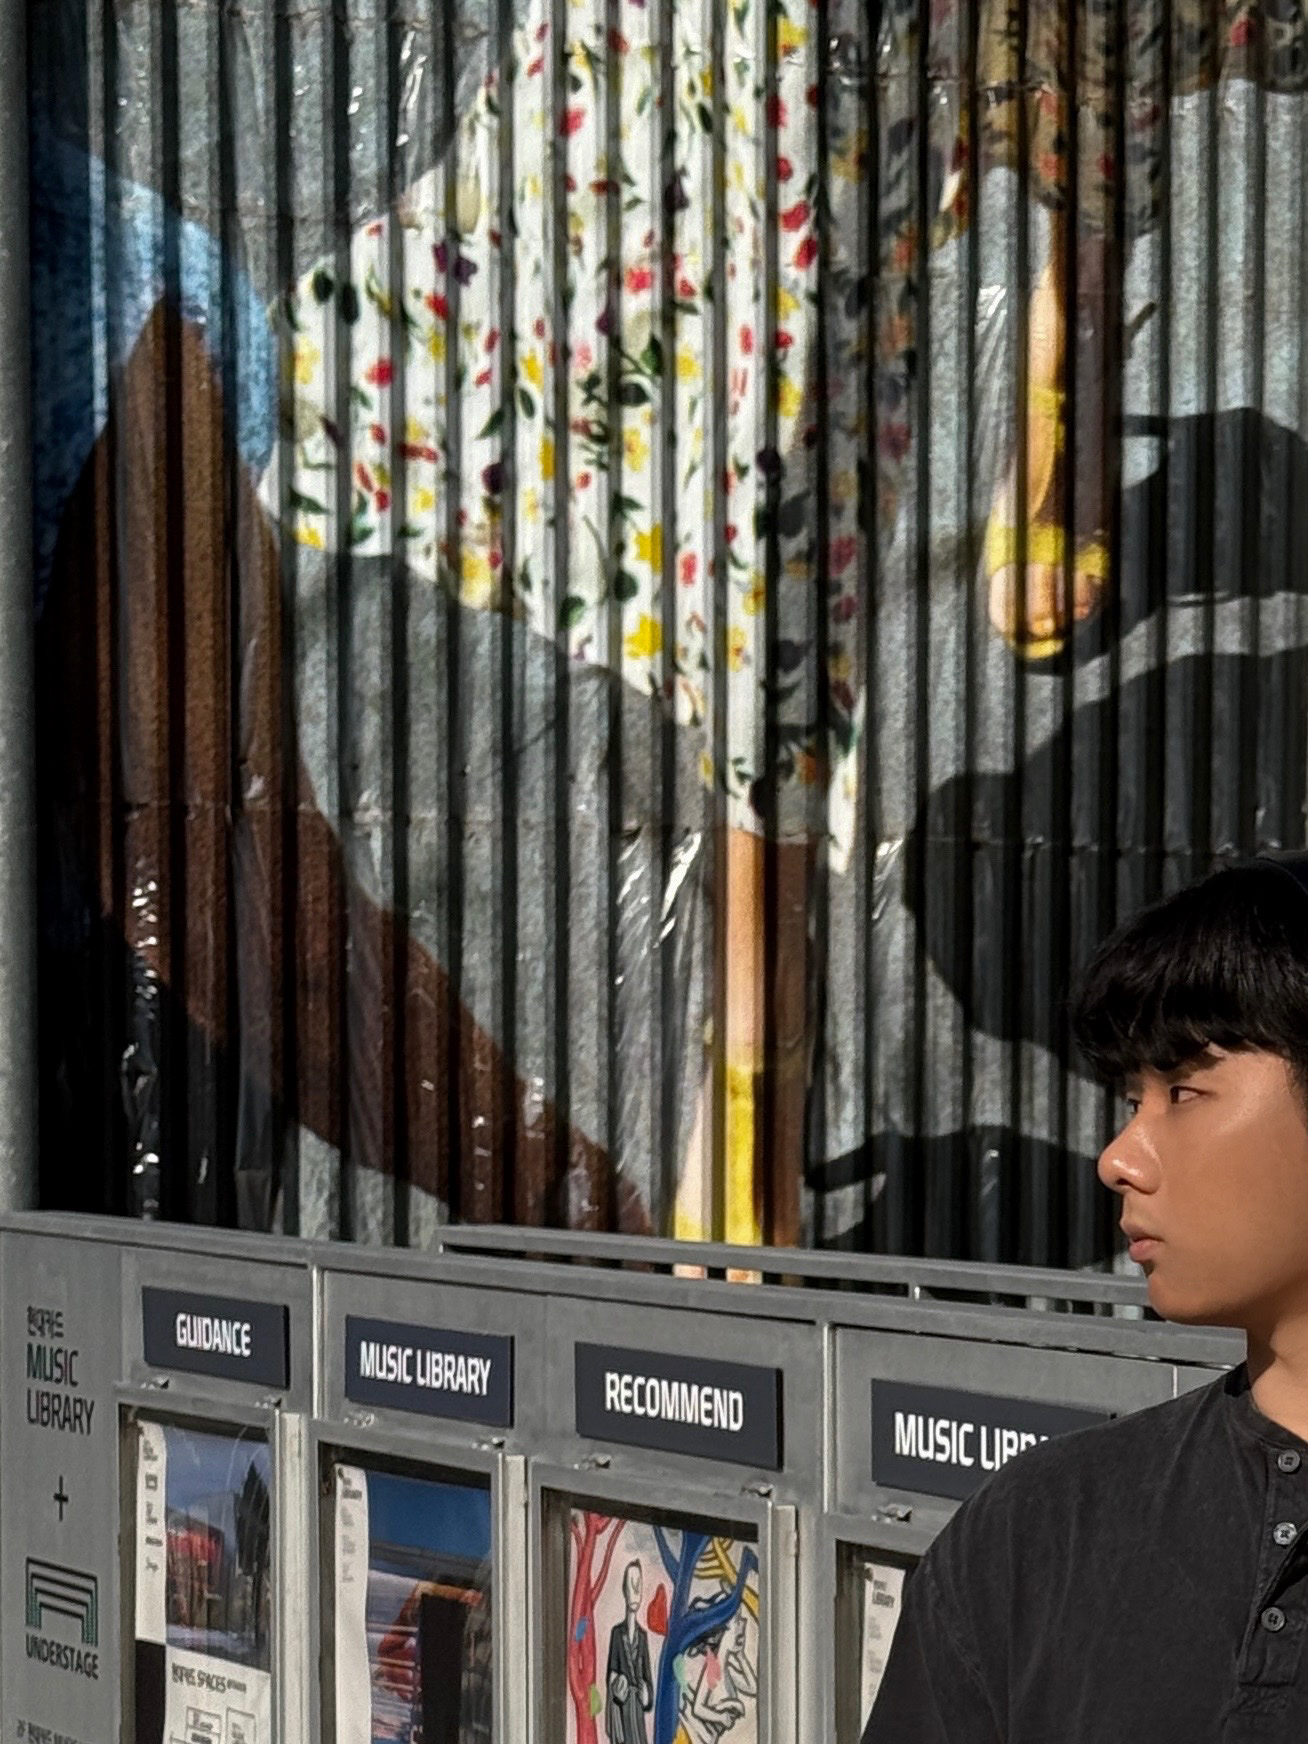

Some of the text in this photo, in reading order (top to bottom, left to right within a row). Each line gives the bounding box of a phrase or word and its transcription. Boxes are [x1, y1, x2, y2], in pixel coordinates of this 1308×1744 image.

[176, 1312, 251, 1358] GUIDANCE
[27, 1342, 79, 1388] MUSIC
[360, 1340, 491, 1396] MUSIC LIBRARY
[27, 1387, 95, 1436] LIBRARY
[604, 1371, 744, 1432] RECOMMEND
[894, 1411, 974, 1467] MUSIC
[26, 1633, 99, 1680] UNDERSTAGE
